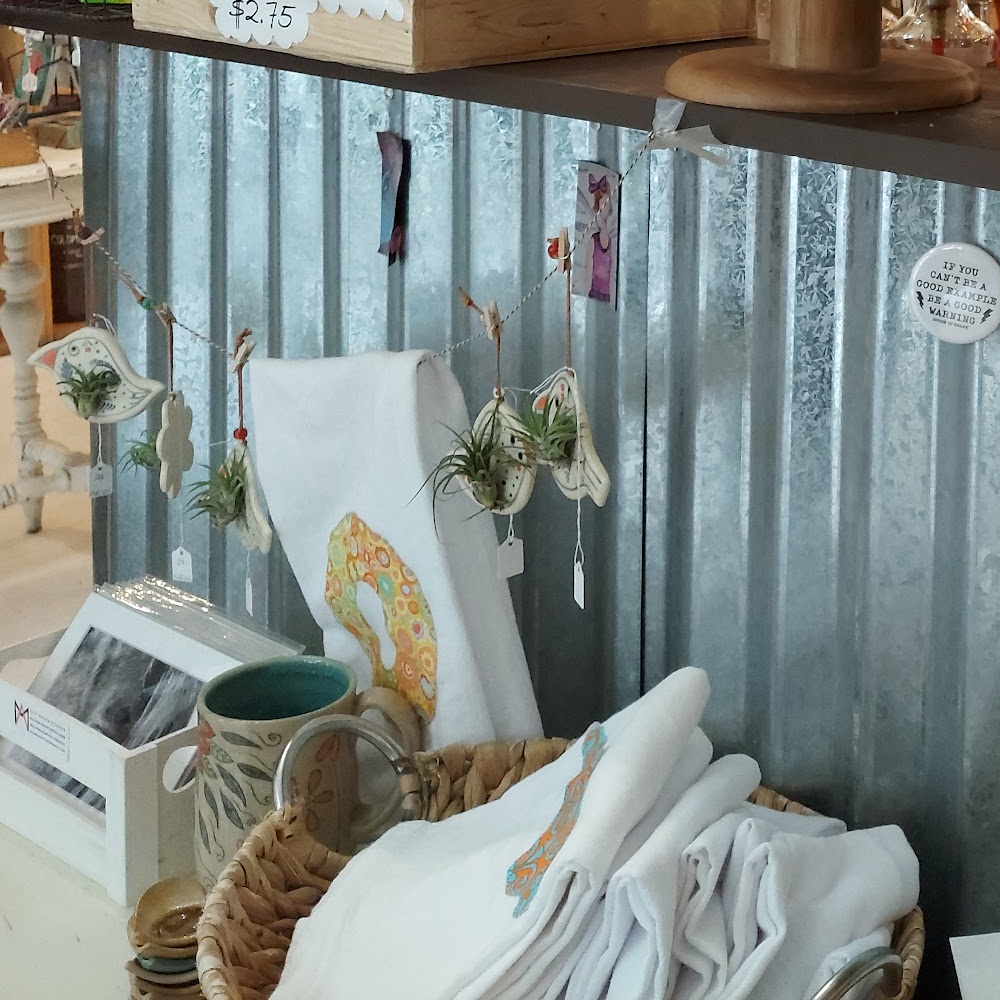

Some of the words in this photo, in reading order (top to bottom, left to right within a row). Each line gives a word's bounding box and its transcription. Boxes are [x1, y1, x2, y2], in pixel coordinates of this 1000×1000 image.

[943, 261, 956, 271] IF
[959, 265, 979, 277] YOU
[930, 270, 960, 284] CAN'T
[963, 278, 977, 289] BE
[979, 283, 987, 291] A
[916, 279, 943, 293] GOOD
[946, 286, 997, 306] EXAMPLE
[927, 294, 941, 305] BE
[944, 299, 951, 307] A
[954, 301, 982, 314] GOOD
[929, 306, 976, 325] WARNING
